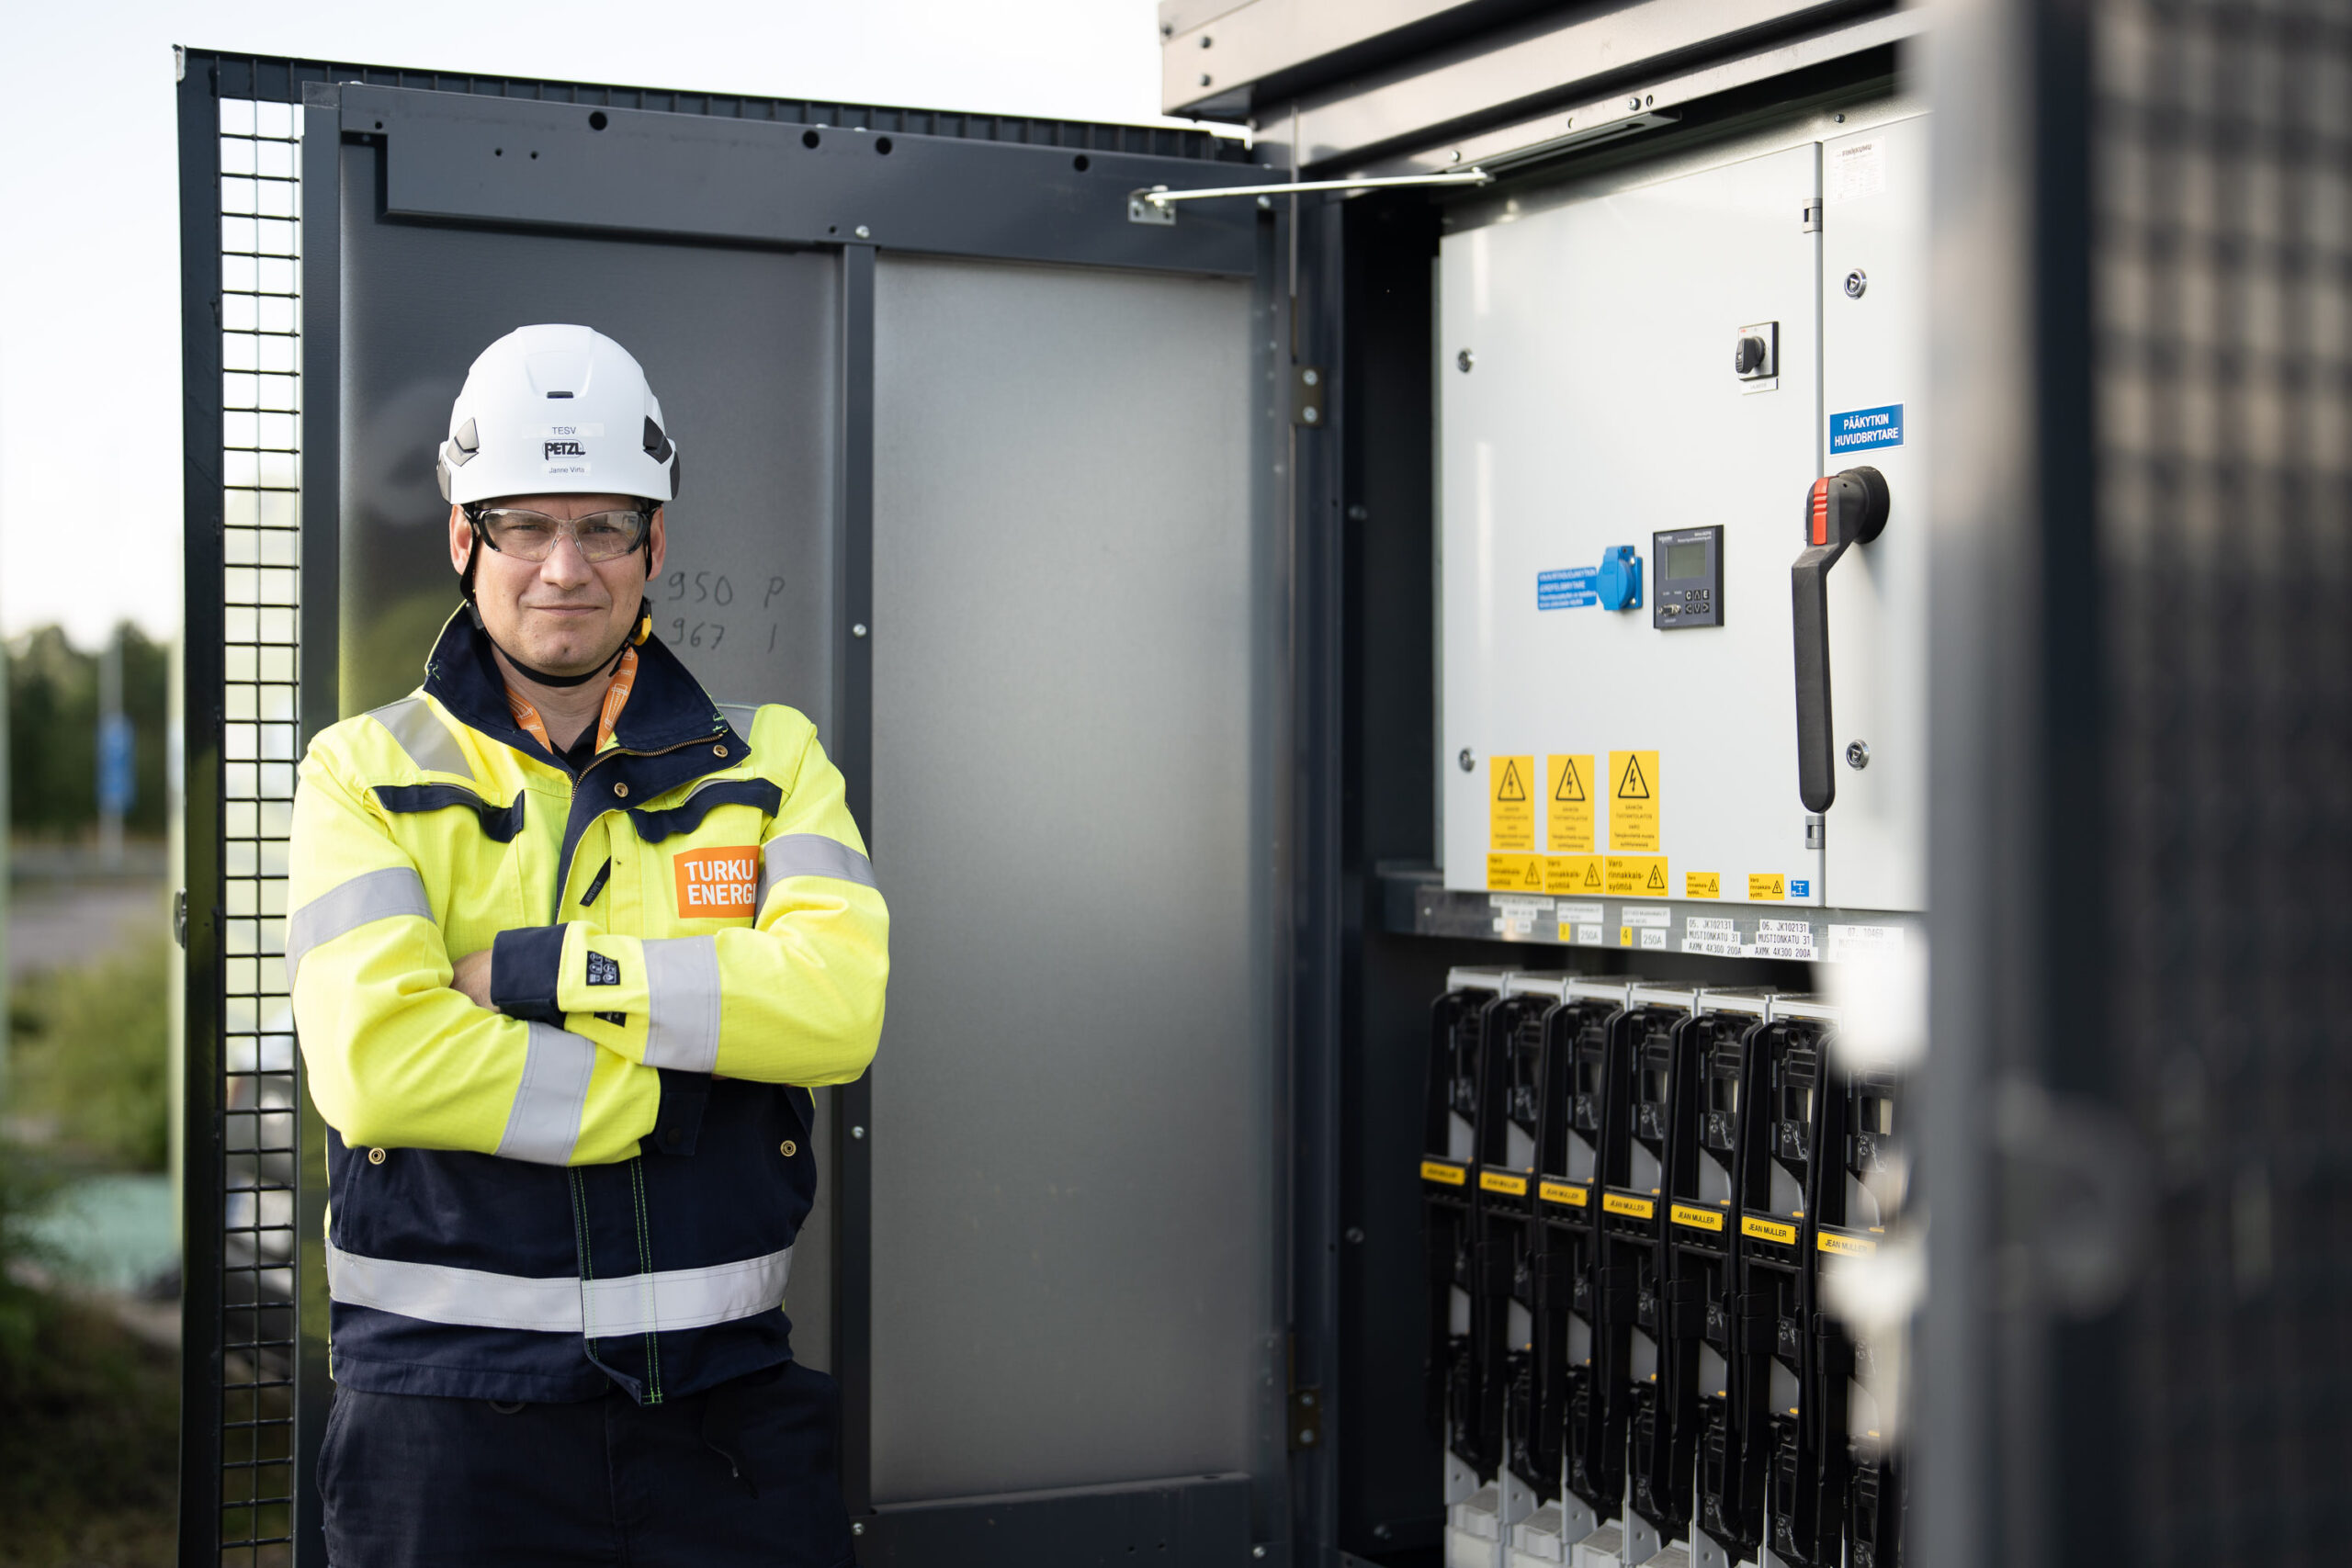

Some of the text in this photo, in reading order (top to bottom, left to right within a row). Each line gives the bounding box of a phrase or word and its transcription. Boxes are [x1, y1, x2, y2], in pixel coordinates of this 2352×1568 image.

[1843, 413, 1889, 431] PÄÄKYTKIN
[552, 426, 577, 434] TESV
[1834, 427, 1898, 446] HUVUDBRYTARE
[544, 442, 586, 461] PETZL
[668, 570, 733, 606] 950
[668, 617, 725, 650] 967
[684, 859, 753, 882] TURKU
[1776, 921, 1806, 933] JK102131
[1623, 929, 1663, 945] 4 250A
[1689, 931, 1738, 942] MUSTIONKATU 31
[1758, 933, 1810, 945] MUSTIONKATU 31
[1727, 946, 1742, 955] 200A
[1755, 946, 1811, 958] AXMK 4X300 200A
[1678, 1212, 1691, 1221] JEAN
[1748, 1224, 1762, 1232] JEAN
[1825, 1239, 1840, 1248] JEAN
